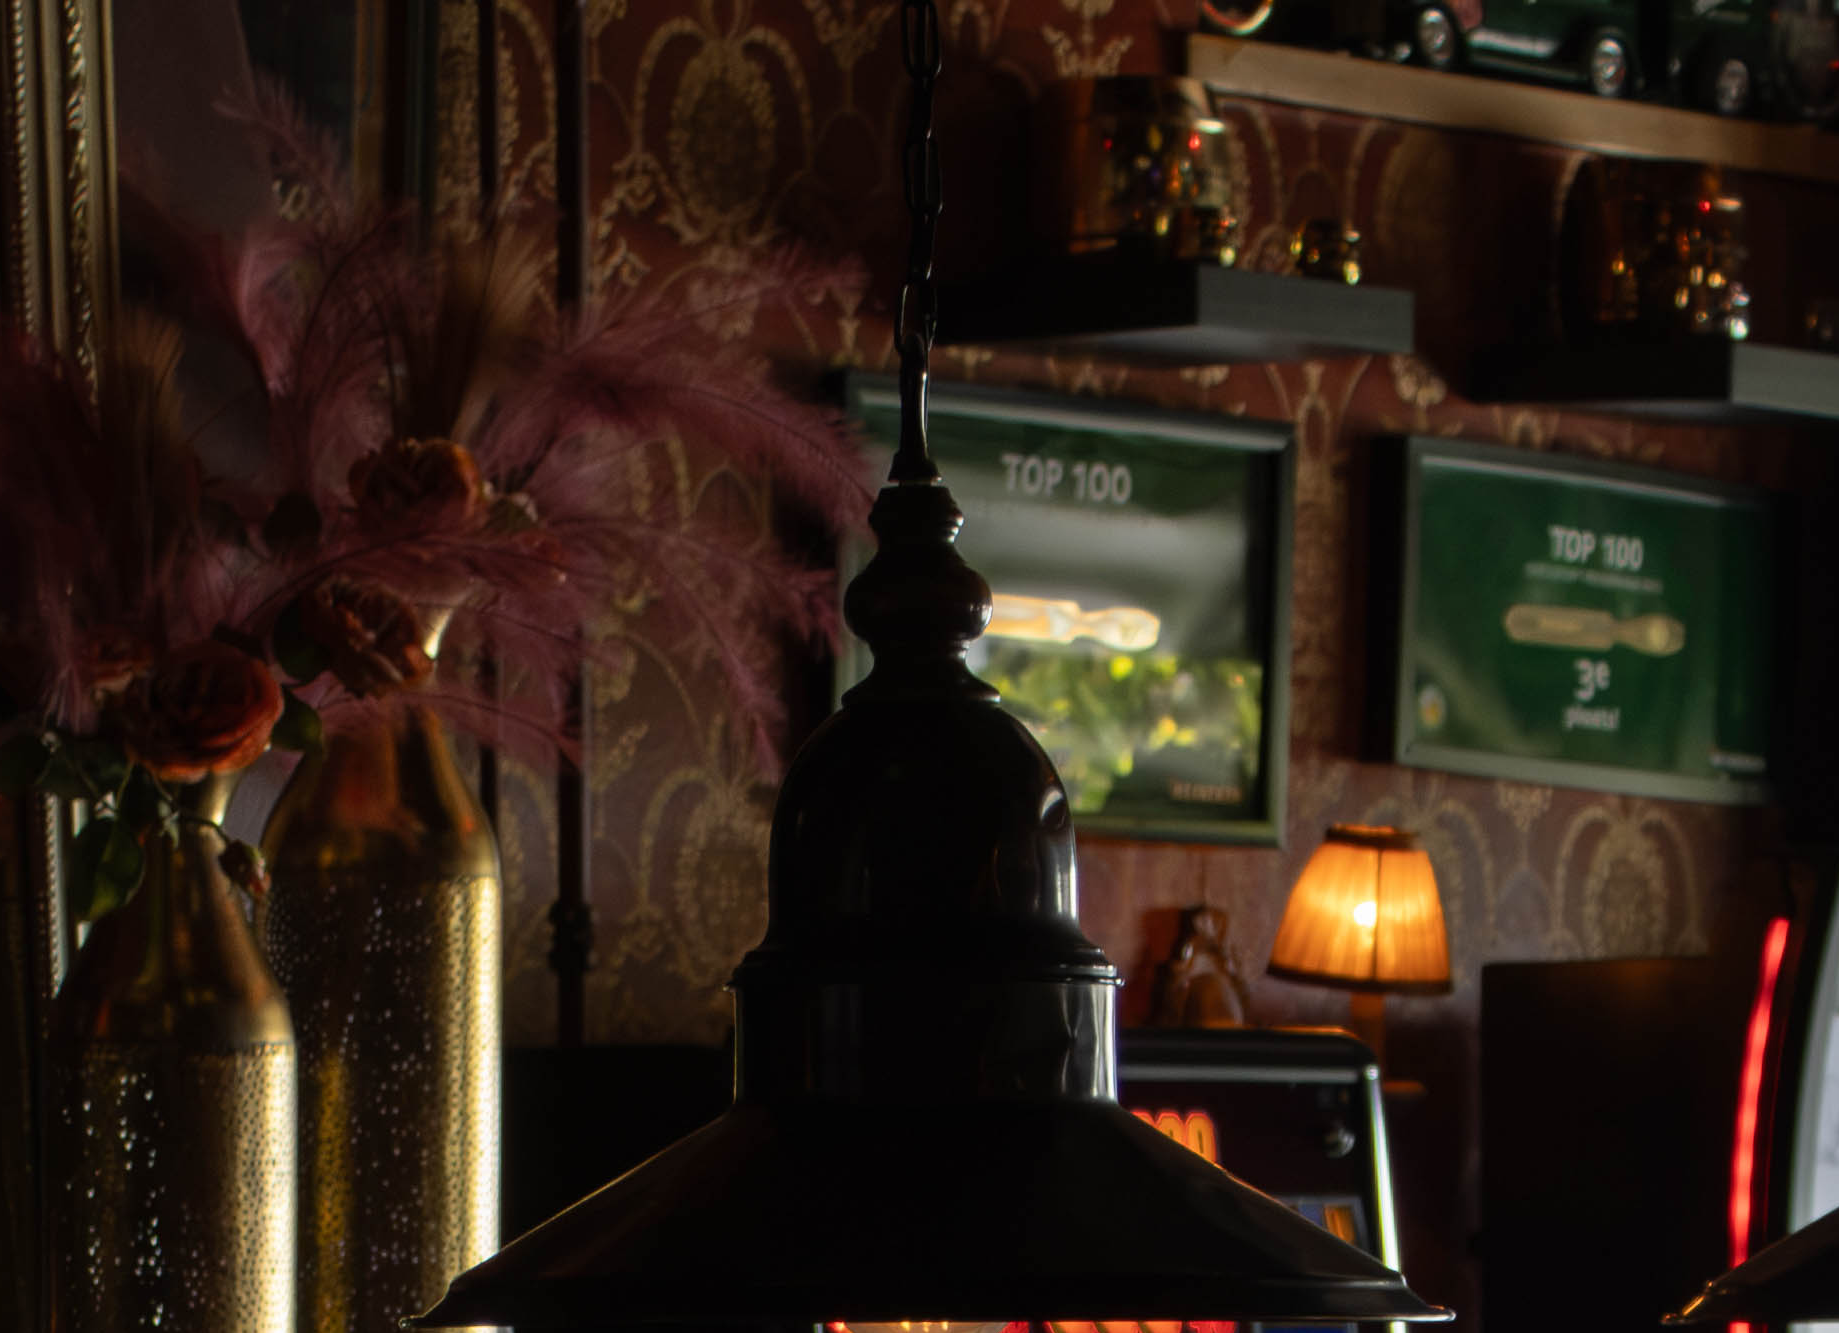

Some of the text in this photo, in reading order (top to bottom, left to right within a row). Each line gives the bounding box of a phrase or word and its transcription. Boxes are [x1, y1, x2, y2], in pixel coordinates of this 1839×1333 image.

[1000, 452, 1133, 504] TOP 100
[1548, 524, 1645, 572] TOP 100
